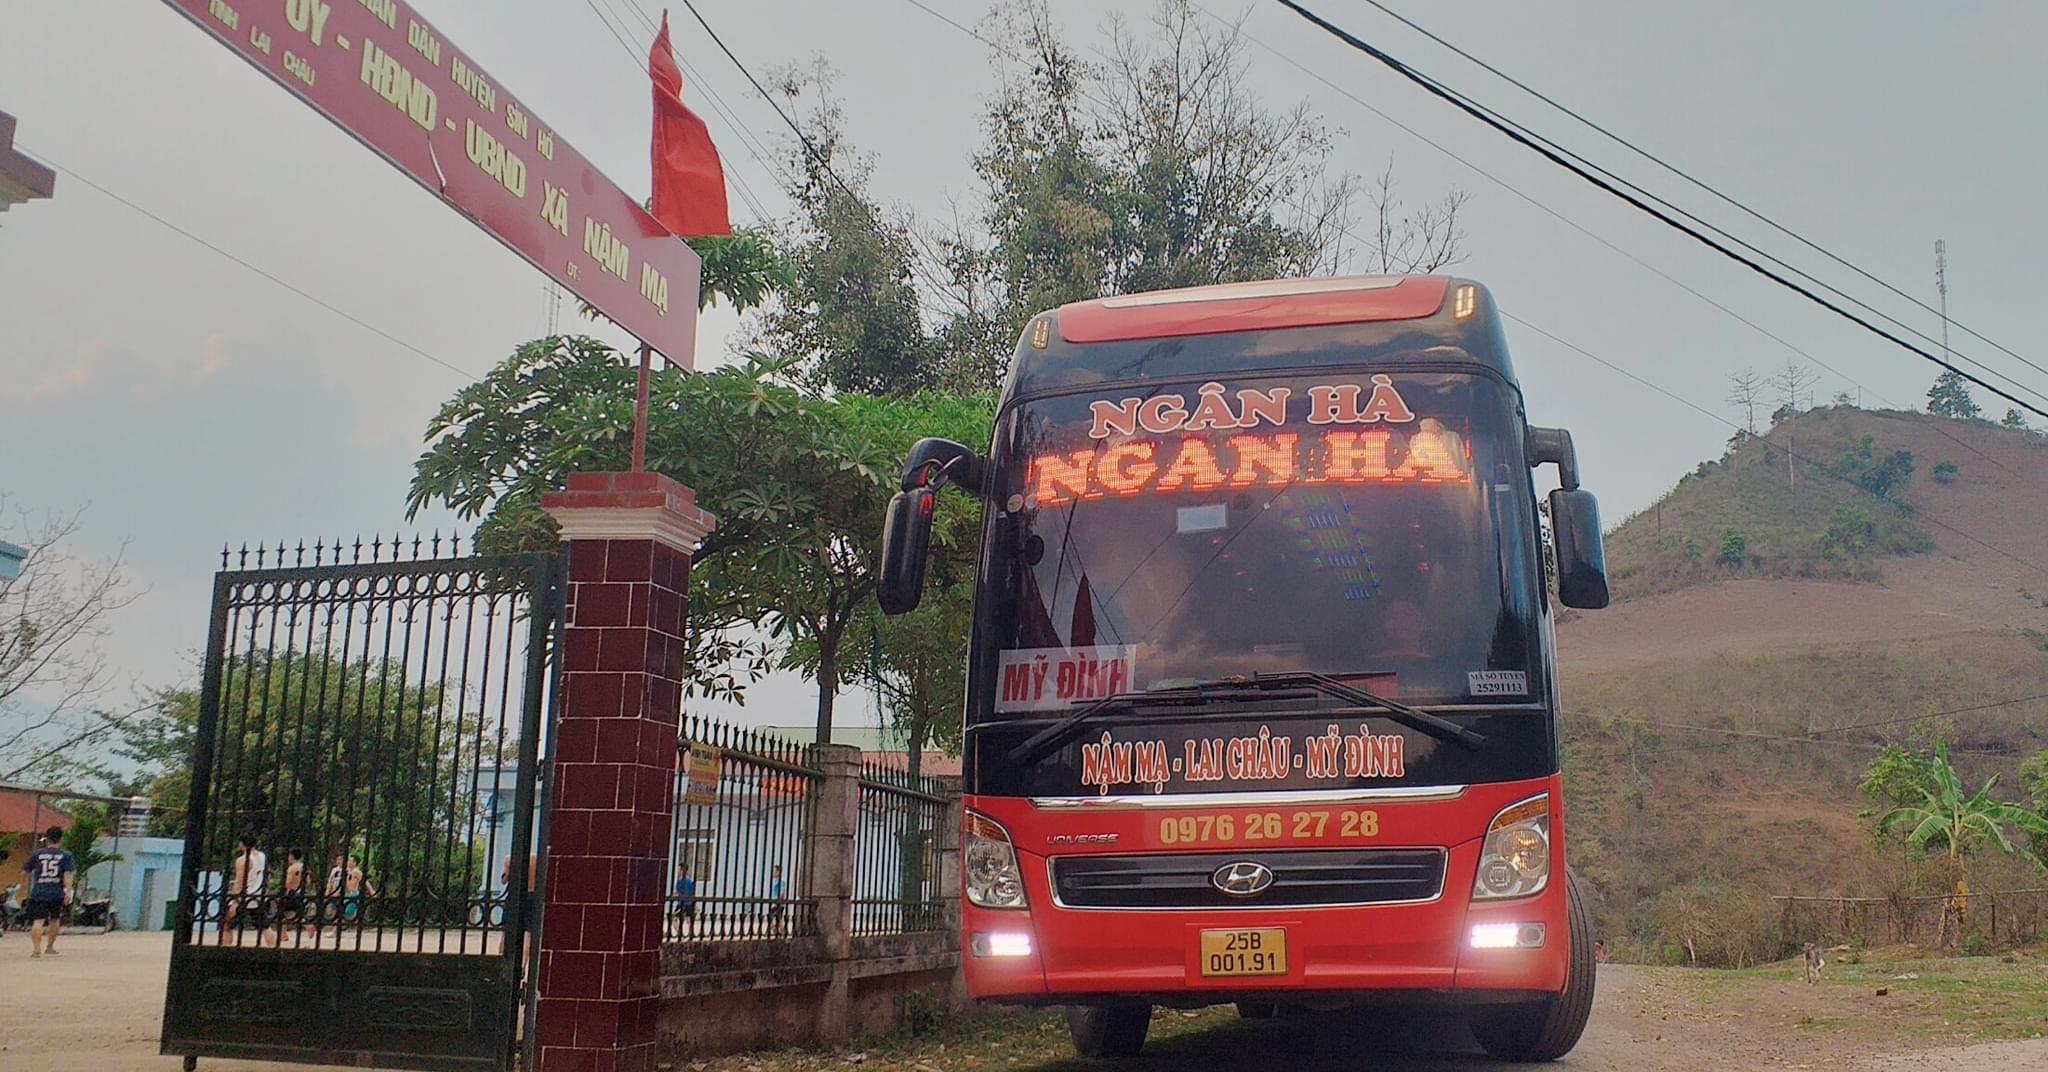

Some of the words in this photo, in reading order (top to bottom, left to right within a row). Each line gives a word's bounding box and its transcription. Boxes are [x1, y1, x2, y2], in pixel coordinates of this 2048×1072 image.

[249, 24, 272, 56] LAI
[283, 49, 316, 87] CHÂU
[407, 18, 440, 67] DÂN
[451, 55, 496, 113] HUYỆN
[505, 102, 527, 141] SÌN
[360, 37, 437, 132] HĐND
[464, 117, 526, 198] UBND
[540, 178, 569, 238] XÃ
[583, 215, 629, 282] NẬM
[640, 260, 668, 318] MẠ
[1089, 381, 1292, 439] NGÂN
[1307, 373, 1416, 425] HÀ
[1002, 654, 1049, 703] MỸ
[1056, 652, 1129, 699] ĐÌNH
[1476, 682, 1523, 693] 25291113
[1081, 730, 1133, 796] NẬM
[1134, 739, 1171, 795] MẠ
[1184, 737, 1224, 781] LAI
[1226, 724, 1291, 780] CHÂU
[1305, 723, 1342, 779] MỸ
[1344, 723, 1406, 778] ĐÌNH
[1046, 833, 1120, 845] UNIVERSE
[1160, 814, 1235, 844] 0976
[1244, 812, 1283, 841] 26
[1292, 811, 1330, 838] 27
[1340, 810, 1379, 838] 28
[40, 859, 60, 877] 15
[1210, 952, 1276, 972] 001.91
[1225, 932, 1262, 951] 25B
